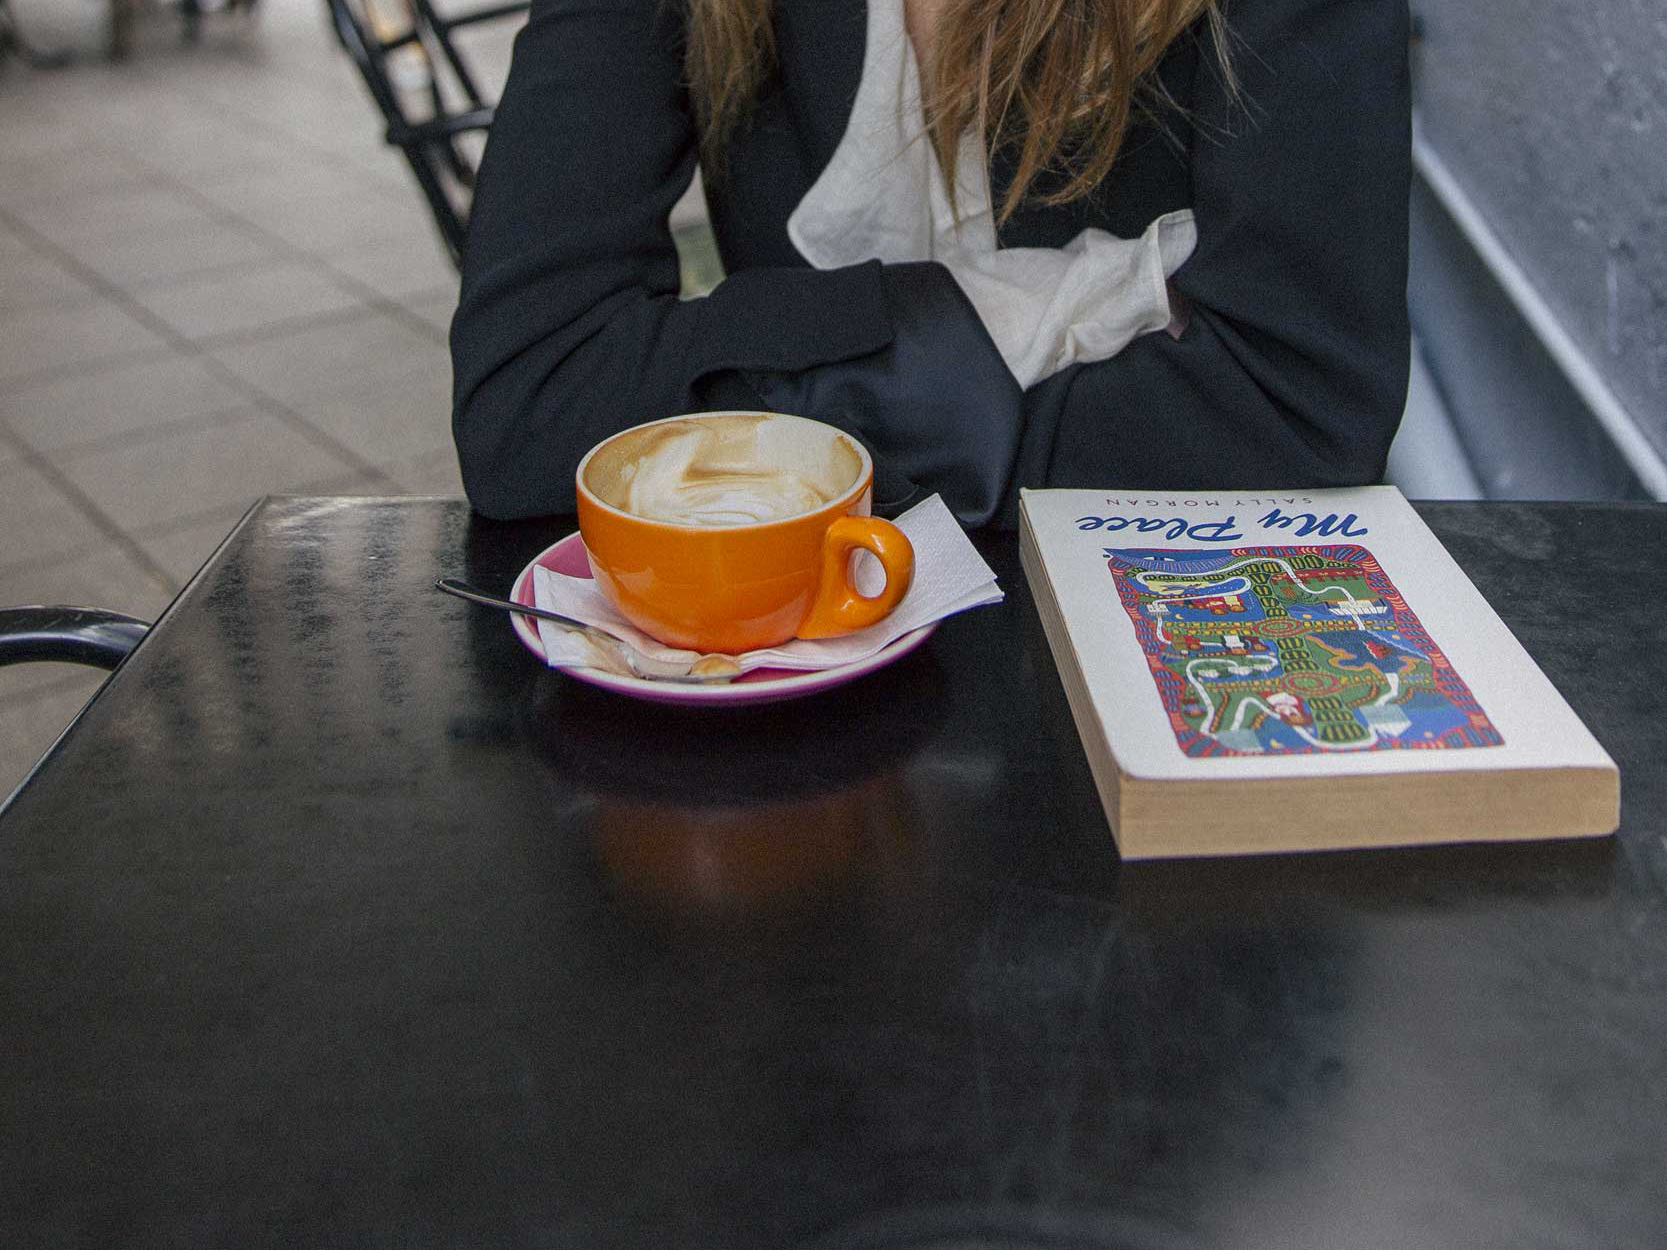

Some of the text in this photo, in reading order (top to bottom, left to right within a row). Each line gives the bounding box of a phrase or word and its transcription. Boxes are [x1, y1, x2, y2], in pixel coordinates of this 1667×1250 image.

[1105, 497, 1313, 507] SALLY MORGAN
[1075, 508, 1369, 542] My Place
